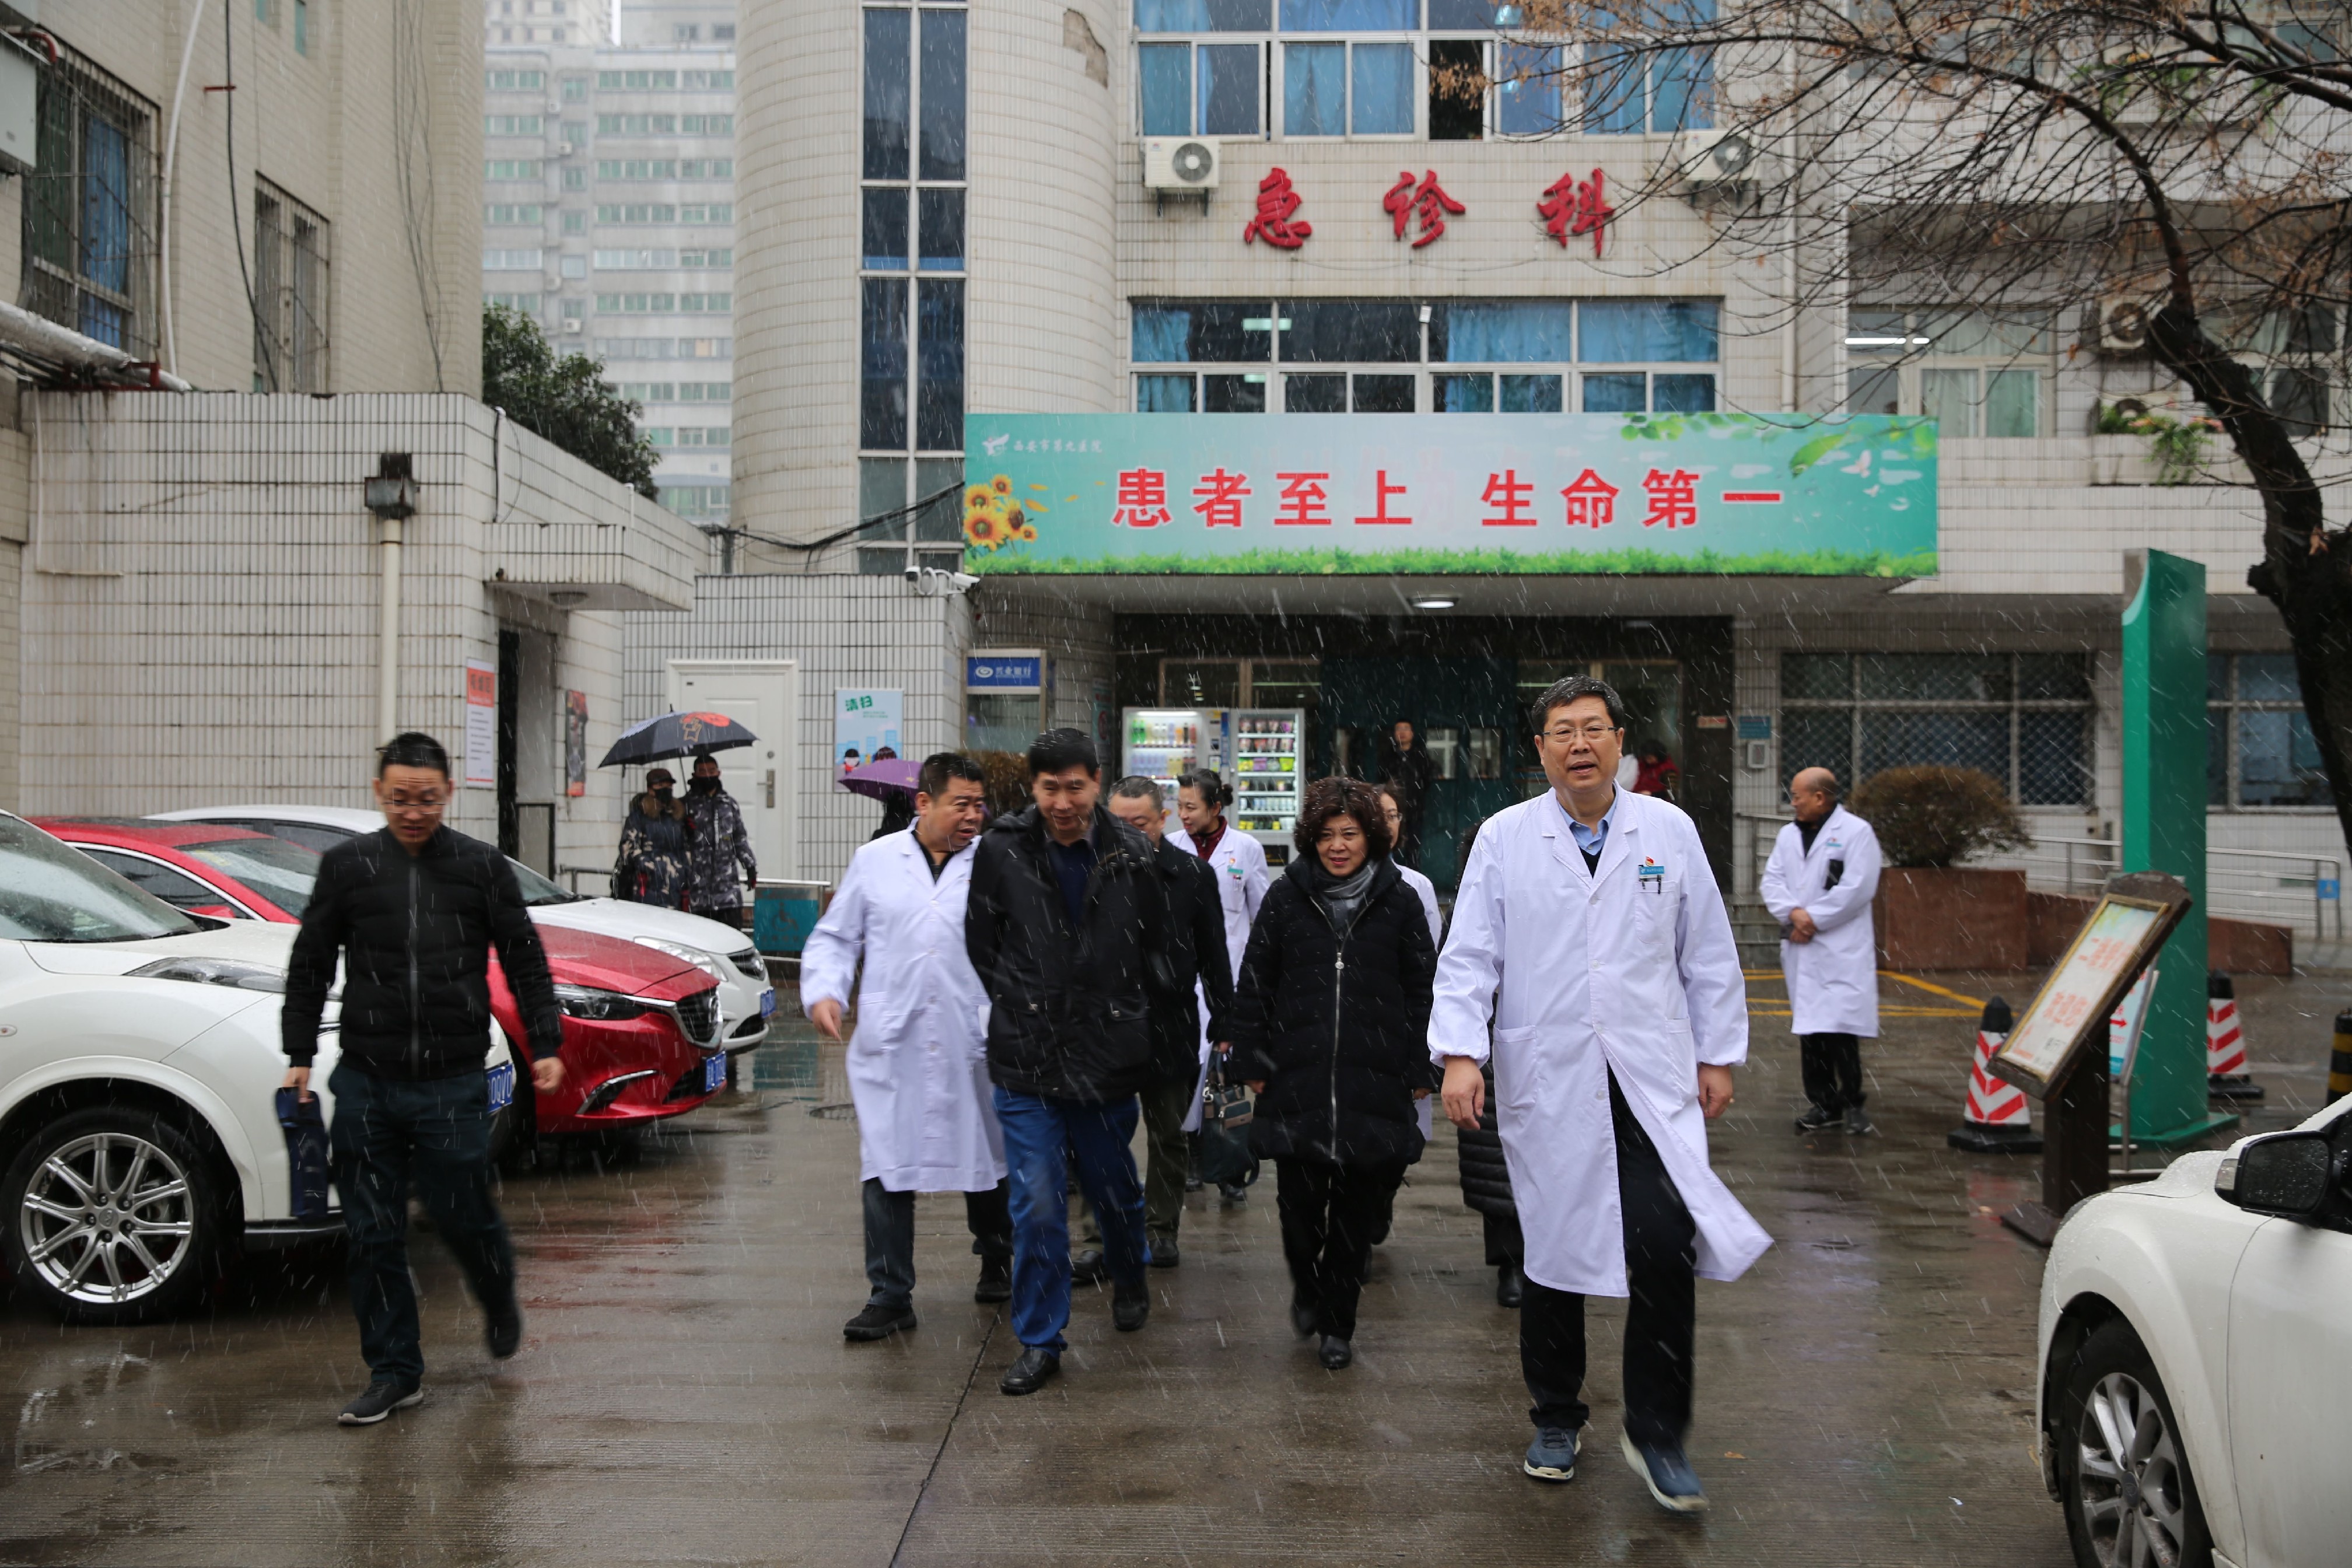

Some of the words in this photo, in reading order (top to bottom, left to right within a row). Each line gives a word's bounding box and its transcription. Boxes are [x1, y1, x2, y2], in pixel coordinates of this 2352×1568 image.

[1244, 167, 1615, 258] 急诊科
[1113, 467, 1413, 528] 患者至上
[1480, 467, 1782, 528] 生命第一
